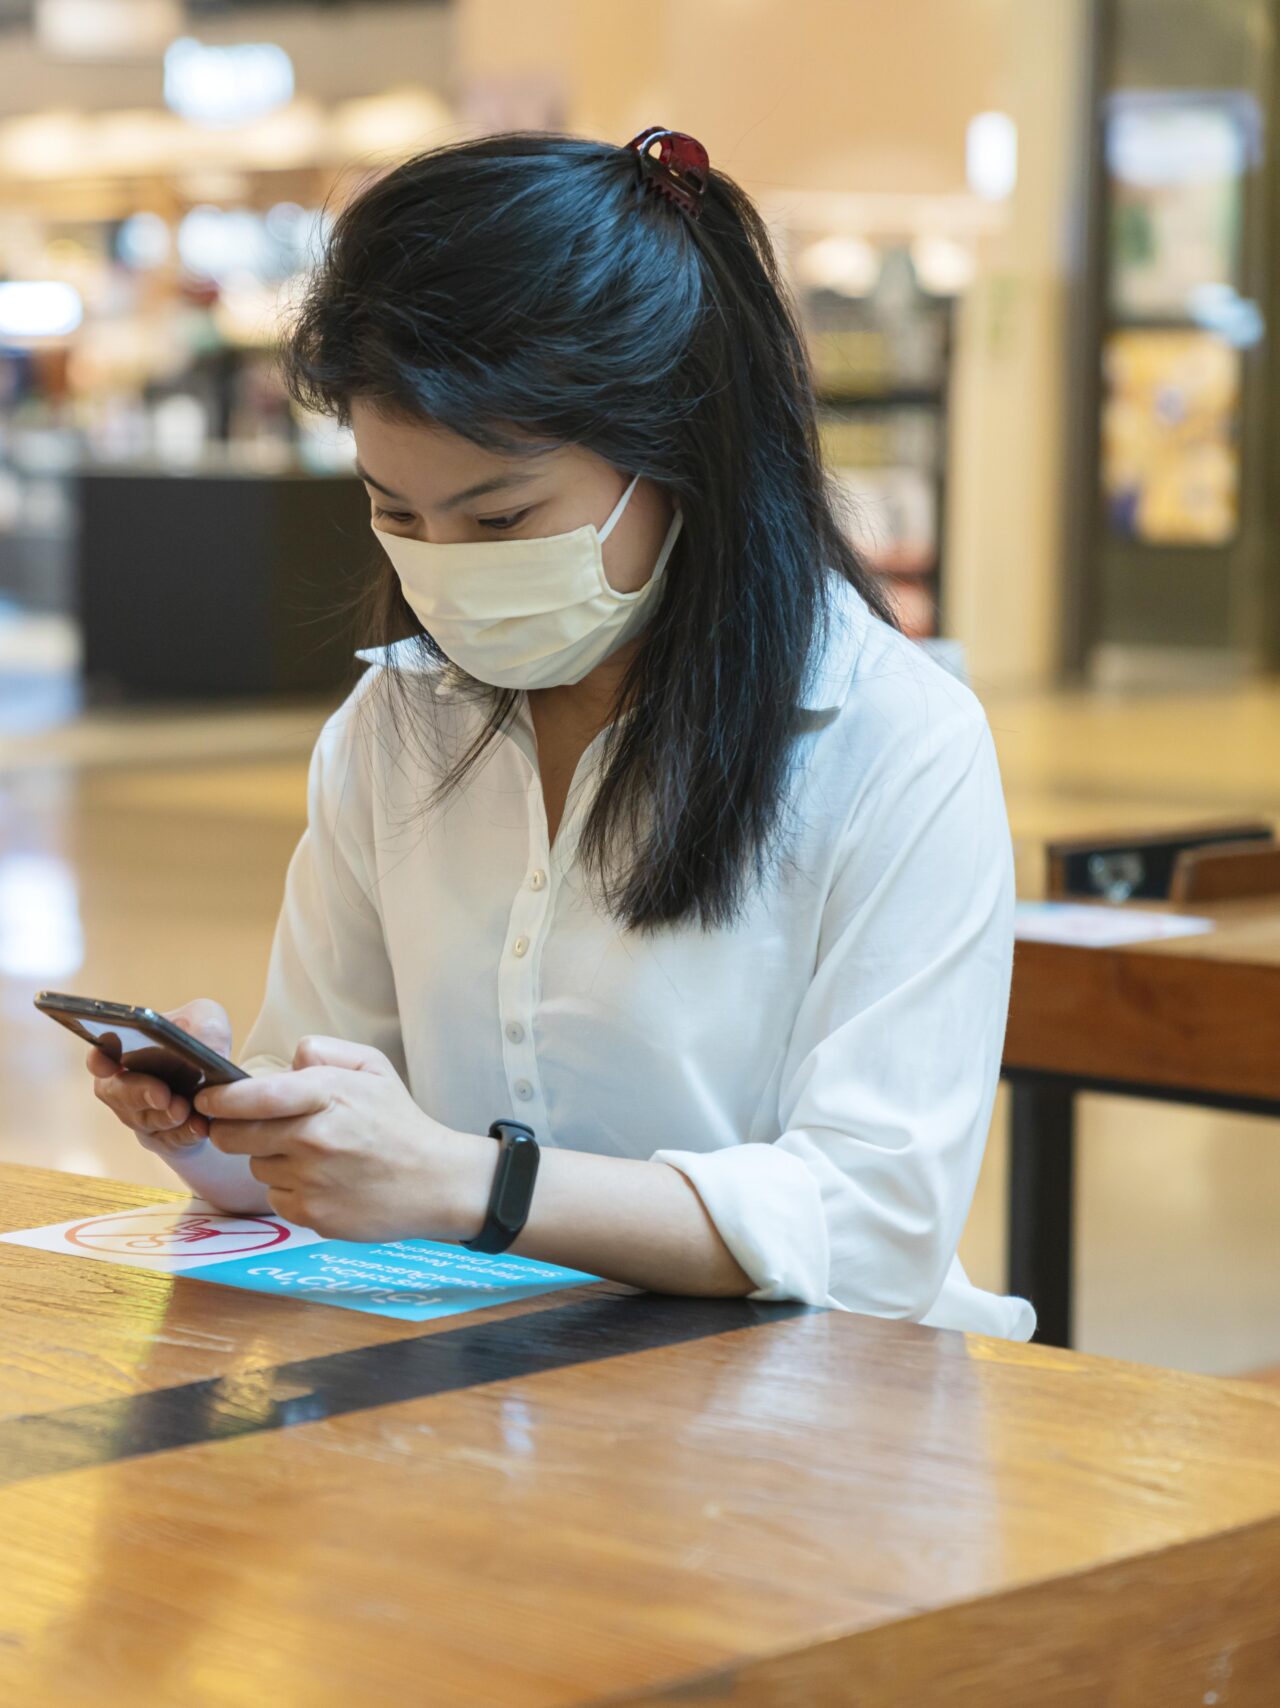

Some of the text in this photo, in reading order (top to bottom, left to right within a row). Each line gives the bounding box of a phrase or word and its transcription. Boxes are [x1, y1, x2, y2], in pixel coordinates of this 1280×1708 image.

[370, 1249, 527, 1280] Please Respect
[380, 1241, 563, 1278] Social Distancing
